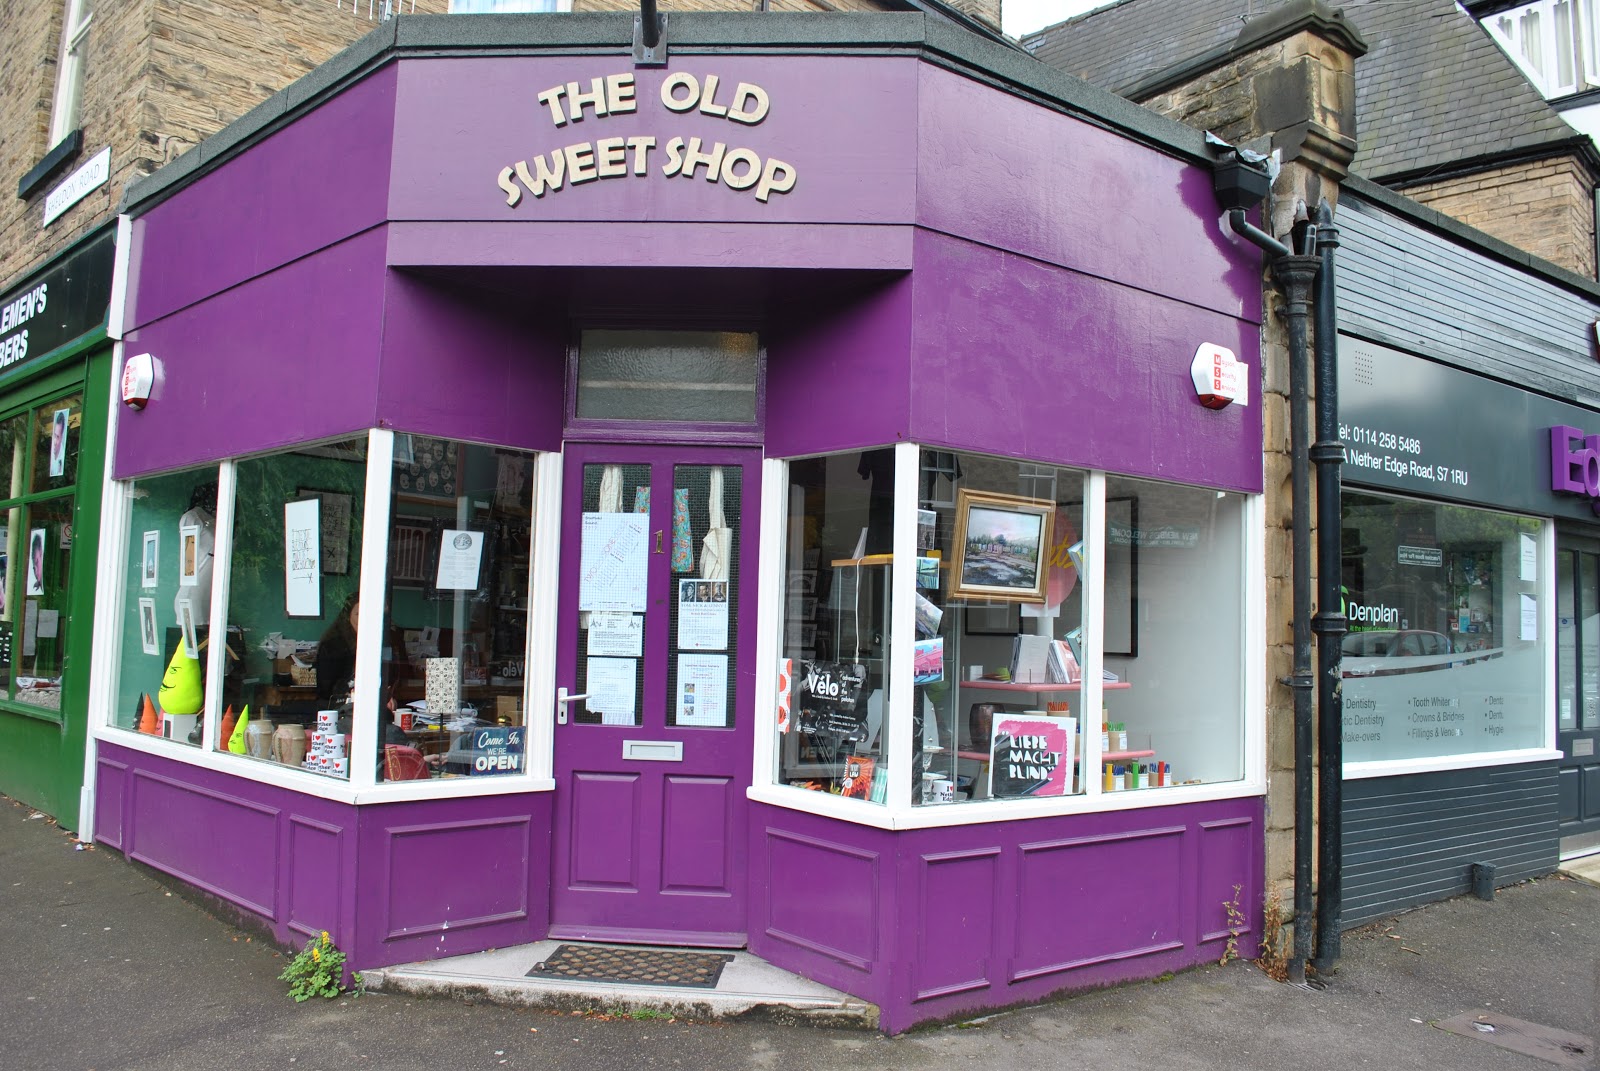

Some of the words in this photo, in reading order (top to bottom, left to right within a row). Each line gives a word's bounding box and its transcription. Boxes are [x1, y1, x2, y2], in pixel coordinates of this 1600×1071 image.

[537, 73, 636, 128] THE
[661, 72, 769, 126] OLD
[497, 137, 656, 208] SWEET
[662, 137, 797, 203] SHOP
[48, 182, 76, 217] SHELDON
[80, 163, 100, 188] ROAD
[0, 283, 48, 335] EMEN'S
[1338, 423, 1351, 440] el:
[1353, 426, 1377, 446] 0114
[1379, 431, 1397, 450] 258
[1398, 436, 1421, 455] 5486
[1350, 448, 1383, 470] Nether
[1384, 455, 1408, 477] Edge
[1409, 460, 1435, 482] Road,
[1436, 465, 1449, 482] S7
[1450, 469, 1468, 486] 1RU
[652, 529, 665, 554] 1
[1349, 601, 1399, 627] Denplan
[807, 673, 839, 697] Vélo
[1346, 698, 1377, 711] Dentistry
[1412, 697, 1430, 708] Tooth
[1354, 714, 1385, 727] Dentistry
[1412, 712, 1436, 723] Crowns
[478, 731, 504, 749] Come
[506, 731, 521, 745] In
[1411, 728, 1434, 741] Fillings
[487, 747, 507, 756] WE'RE
[1009, 749, 1062, 766] MACHT
[475, 754, 519, 772] OPEN
